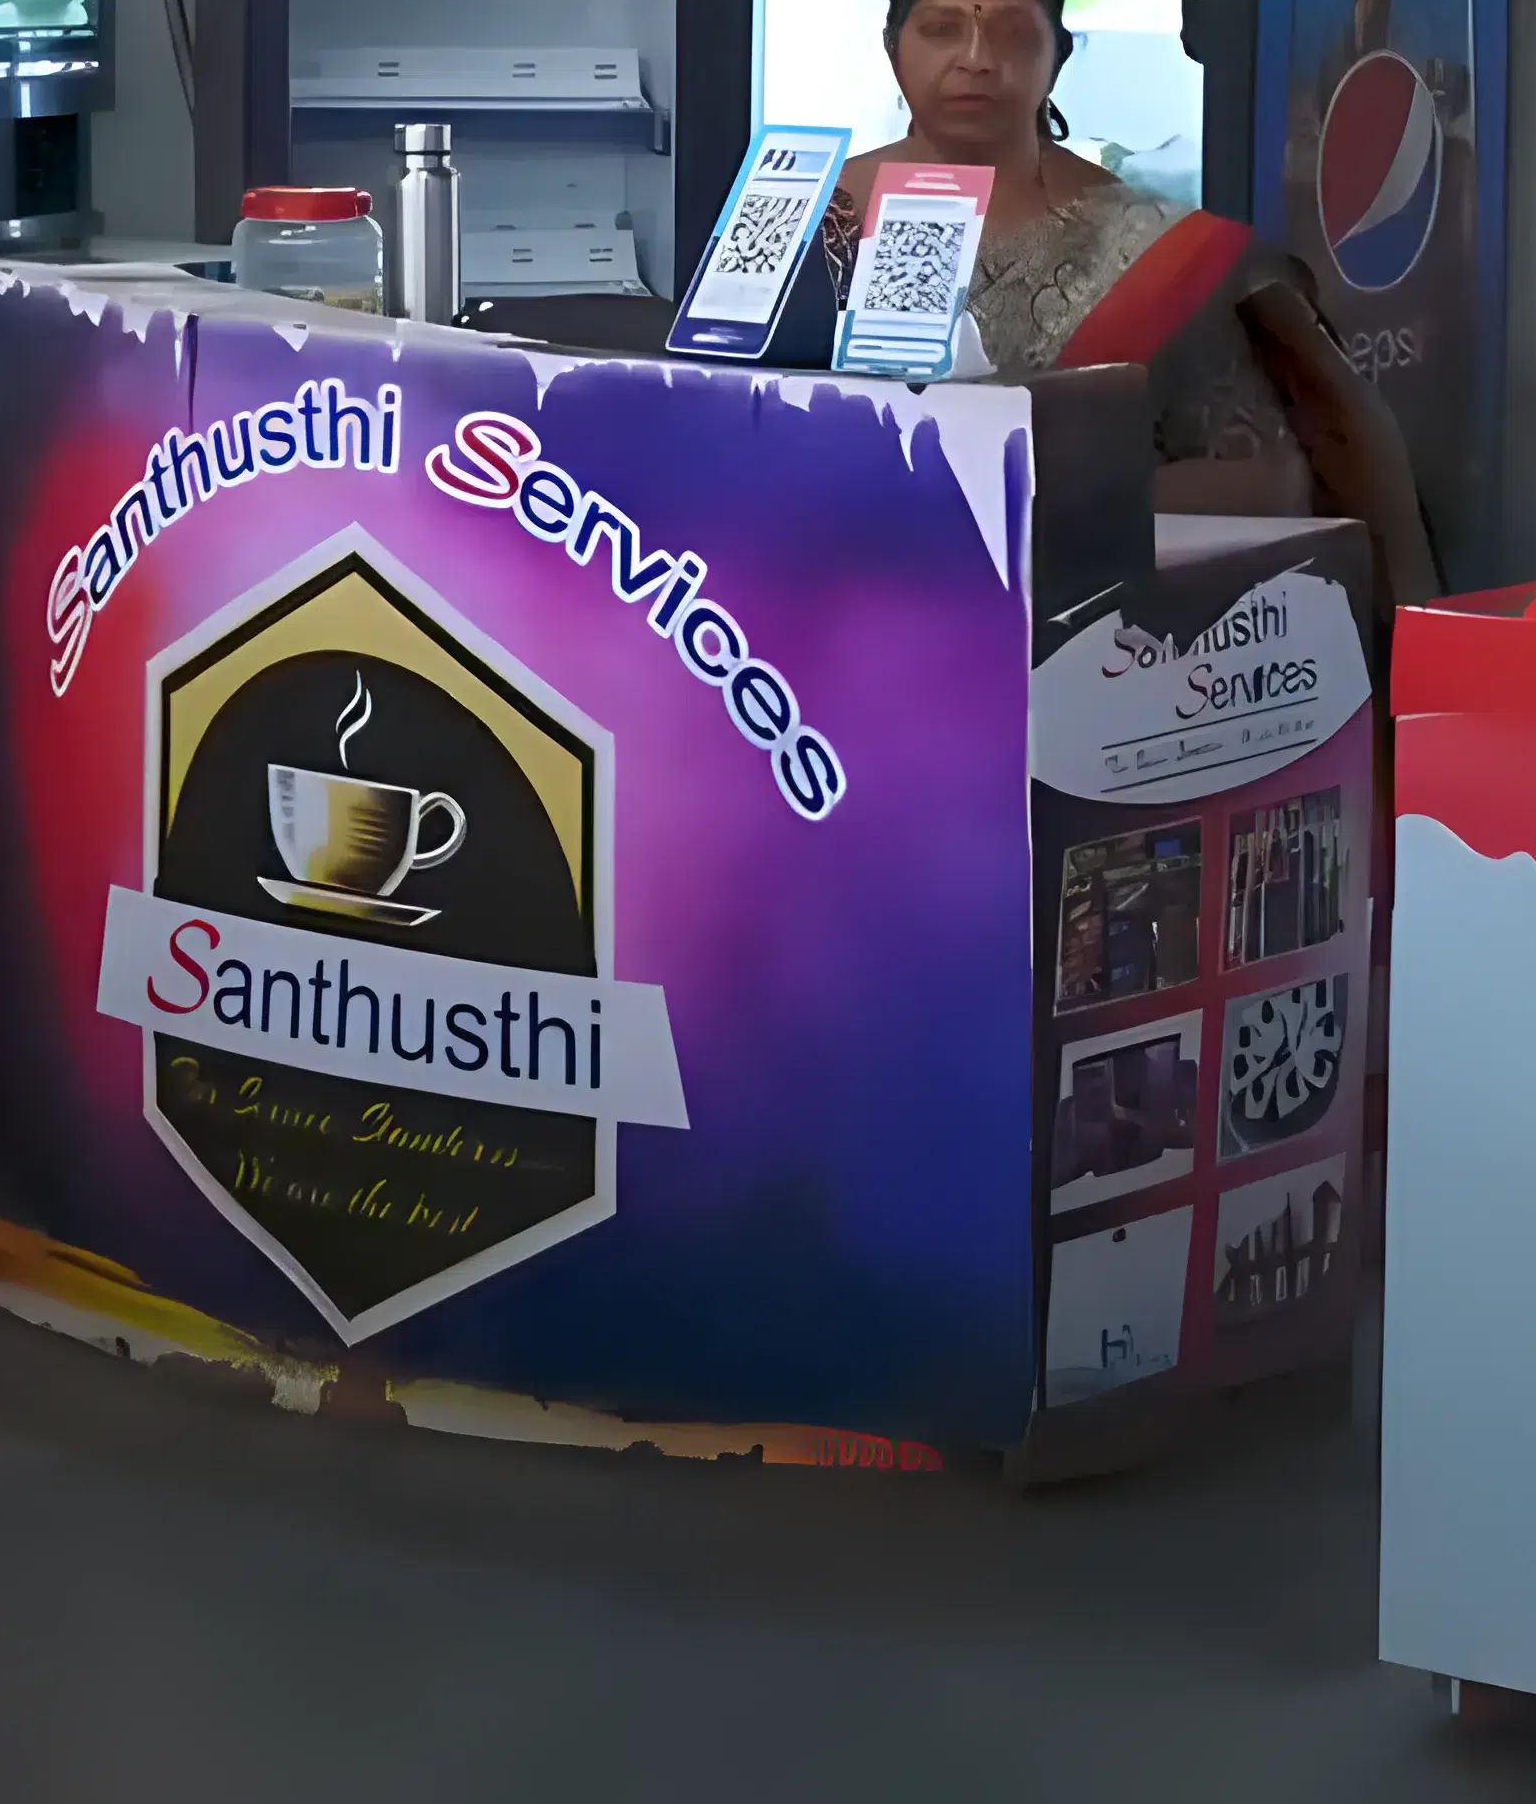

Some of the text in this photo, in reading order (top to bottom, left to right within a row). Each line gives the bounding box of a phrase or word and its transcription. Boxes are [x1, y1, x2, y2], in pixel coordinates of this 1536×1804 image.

[47, 378, 847, 821] Santhusthi Services
[147, 918, 602, 1089] Santhusthi
